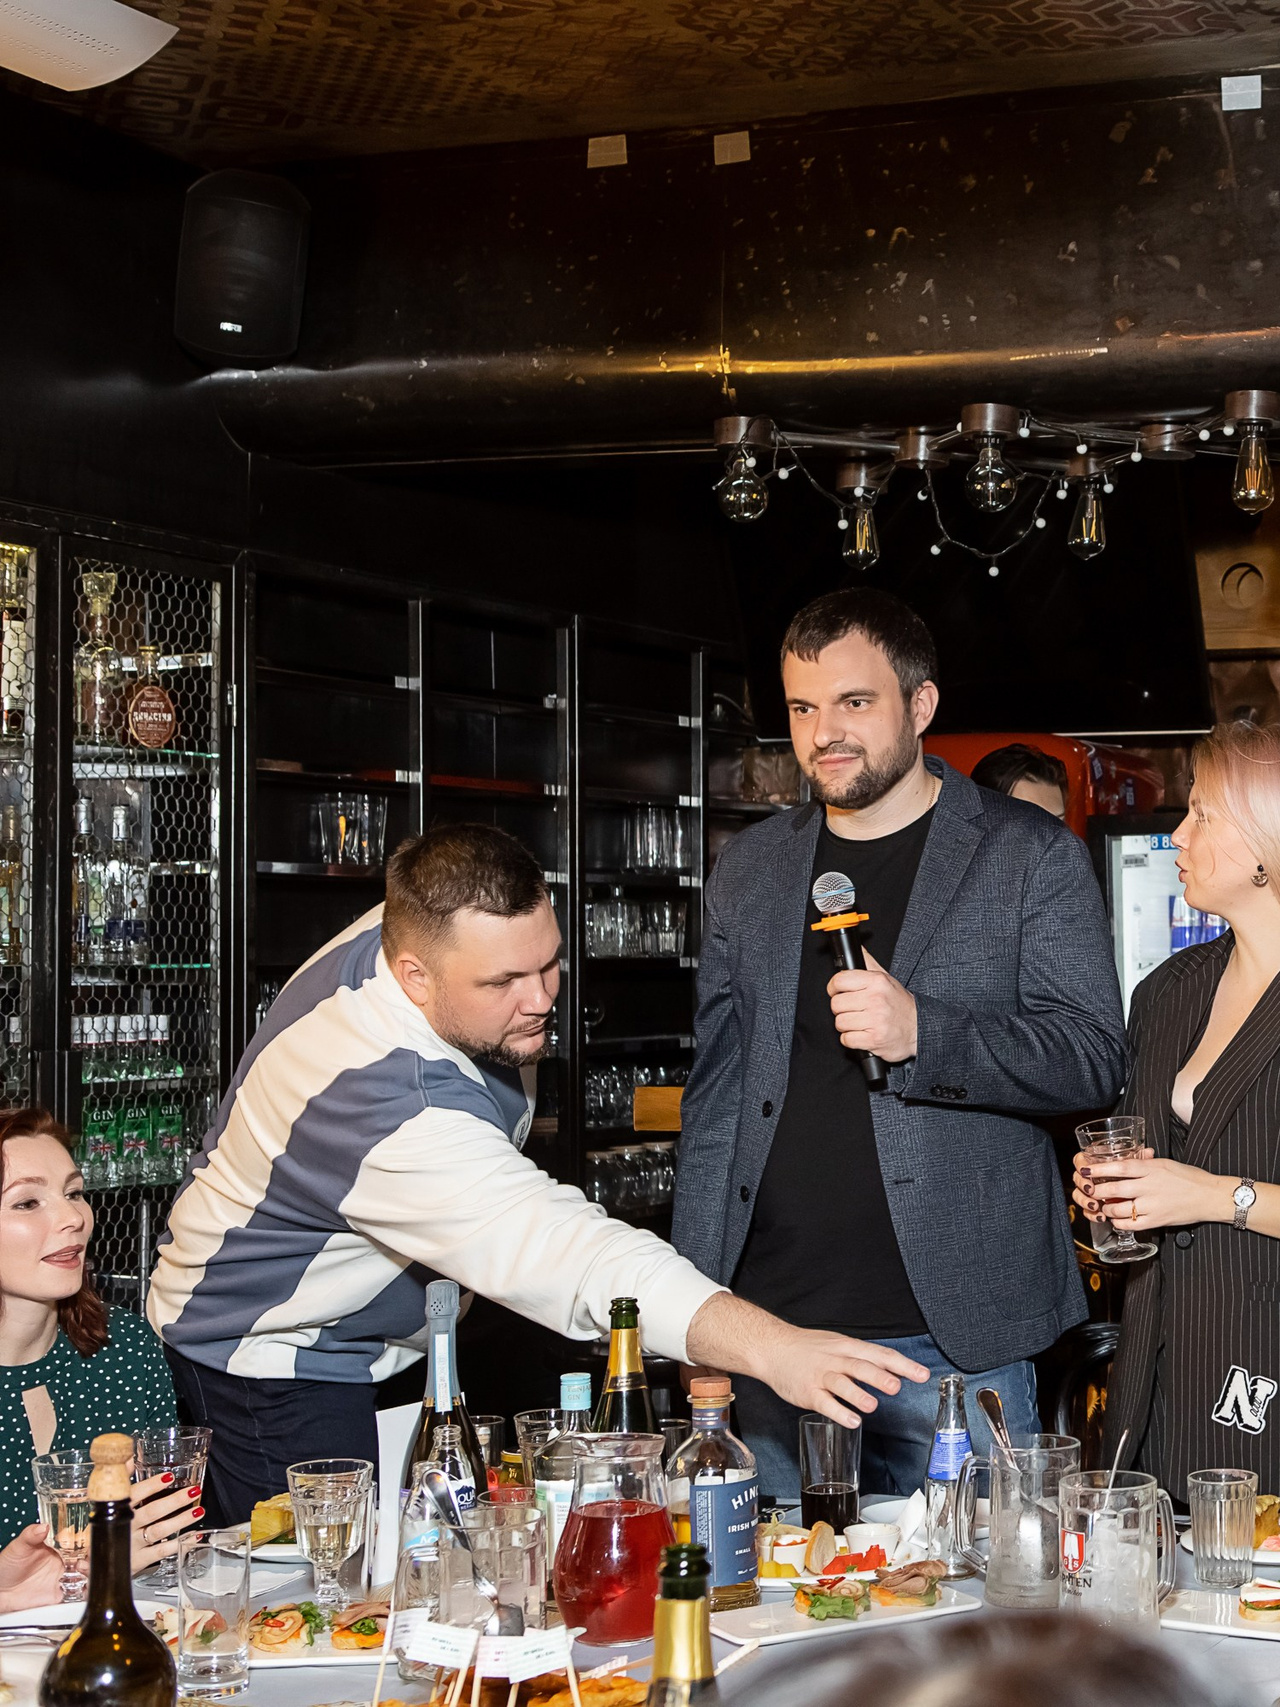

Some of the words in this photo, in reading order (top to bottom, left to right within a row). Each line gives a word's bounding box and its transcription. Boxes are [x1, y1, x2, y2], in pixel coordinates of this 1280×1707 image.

[93, 1109, 114, 1121] GIN
[127, 1107, 147, 1118] GIN
[161, 1104, 181, 1115] GIN
[567, 1393, 581, 1401] GIN
[728, 1522, 750, 1534] IRISH
